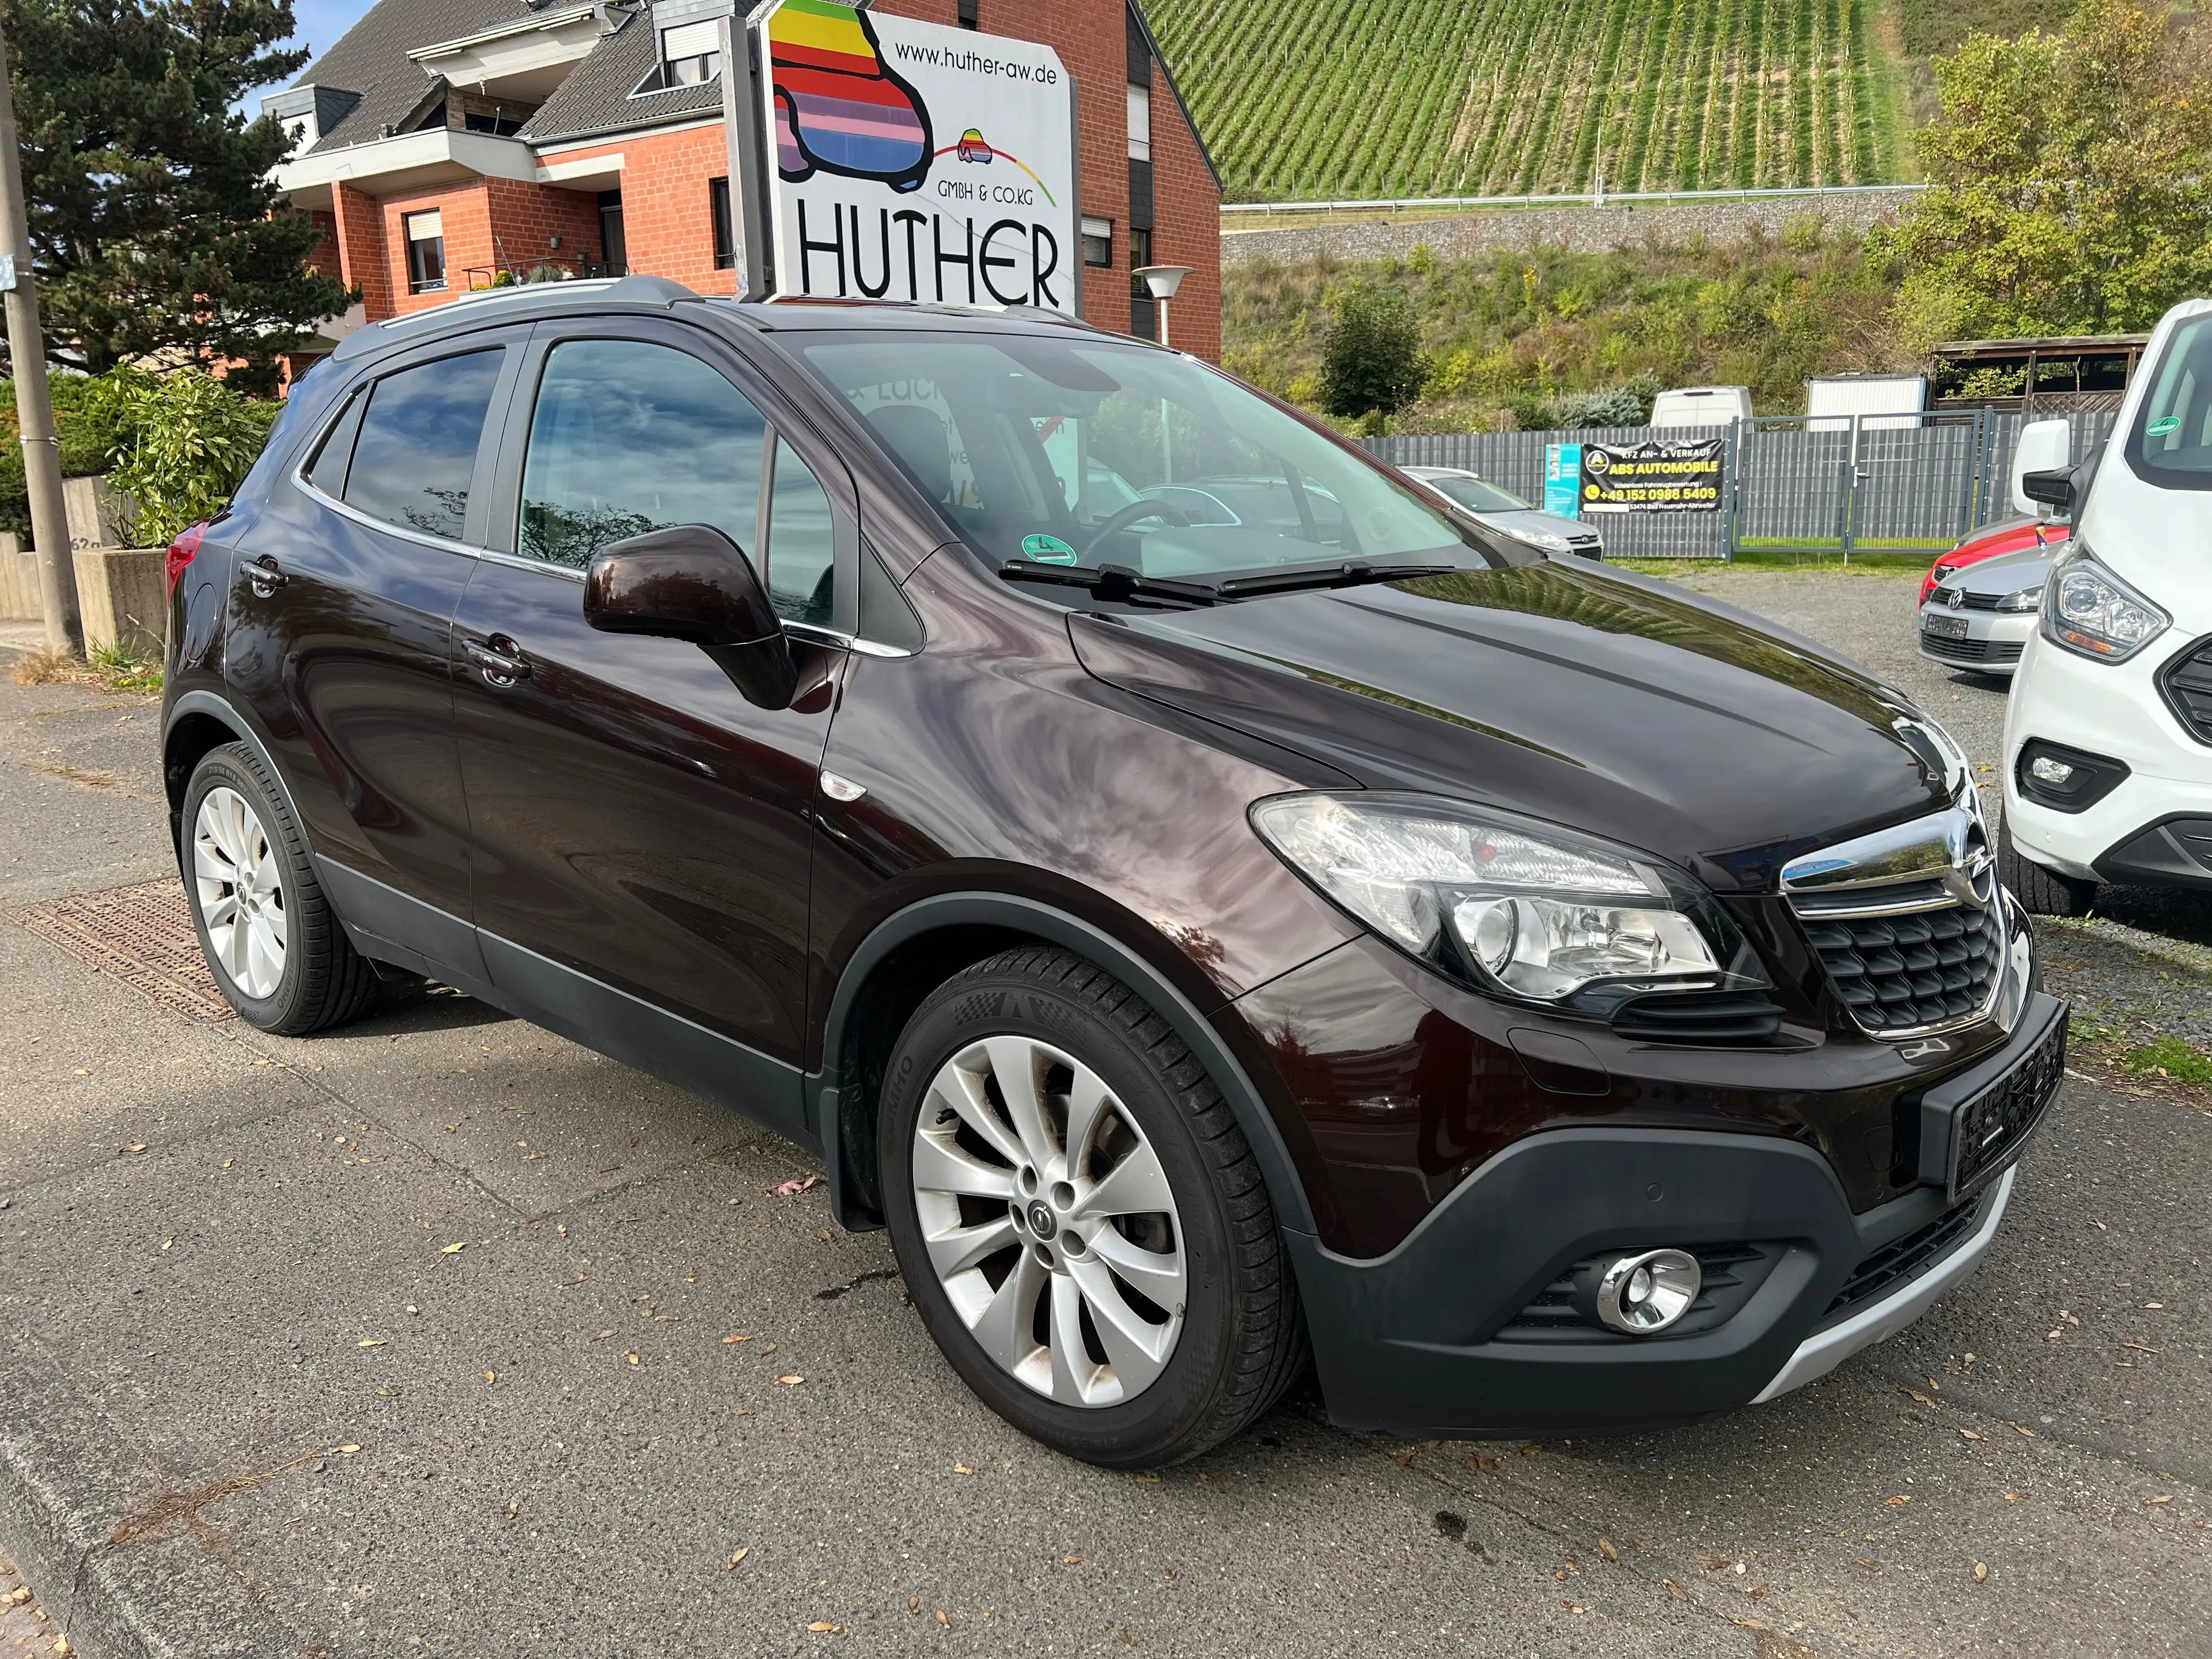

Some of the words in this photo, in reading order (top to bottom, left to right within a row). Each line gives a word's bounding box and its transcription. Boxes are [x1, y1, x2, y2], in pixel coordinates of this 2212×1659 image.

[895, 43, 1056, 85] www.huther-aw.de
[938, 180, 973, 200] GMBH
[979, 185, 987, 201] &
[797, 198, 1059, 308] HUTHER
[1609, 463, 1635, 475] ABS
[1636, 461, 1718, 474] AUTOMOBILE
[1661, 450, 1668, 459] &
[1671, 448, 1711, 457] VERKAUF
[1600, 490, 1625, 501] +49
[1627, 490, 1646, 501] 152
[1649, 488, 1680, 500] 0988
[1683, 487, 1716, 499] 5409
[277, 955, 295, 1009] KUMHO
[884, 1055, 913, 1158] KUMHO
